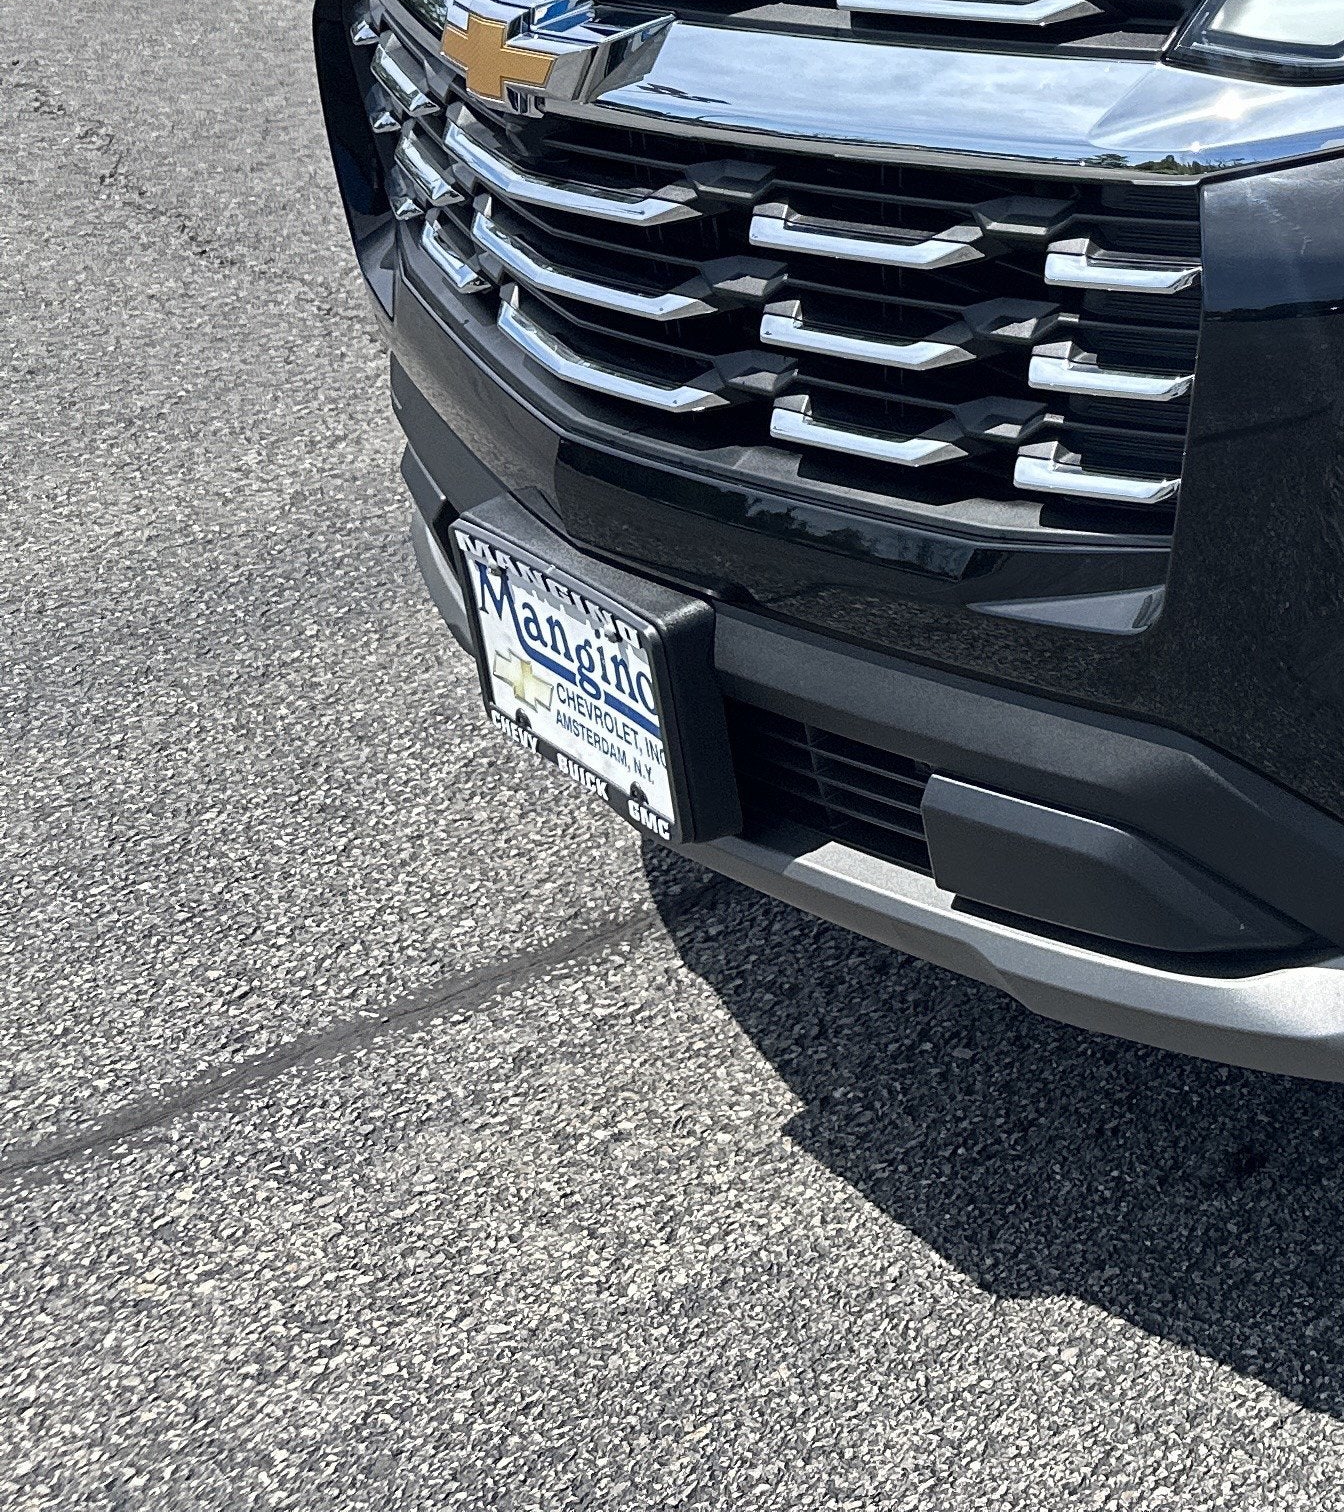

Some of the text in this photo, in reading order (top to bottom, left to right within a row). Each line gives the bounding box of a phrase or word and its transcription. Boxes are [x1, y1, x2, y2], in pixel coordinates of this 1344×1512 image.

[455, 530, 641, 649] MANGINO
[475, 560, 658, 716] Mangino
[491, 709, 671, 841] CHEVY BUICK GMC
[556, 682, 642, 756] CHEVROLET,
[556, 709, 630, 772] AMSTERDAM,
